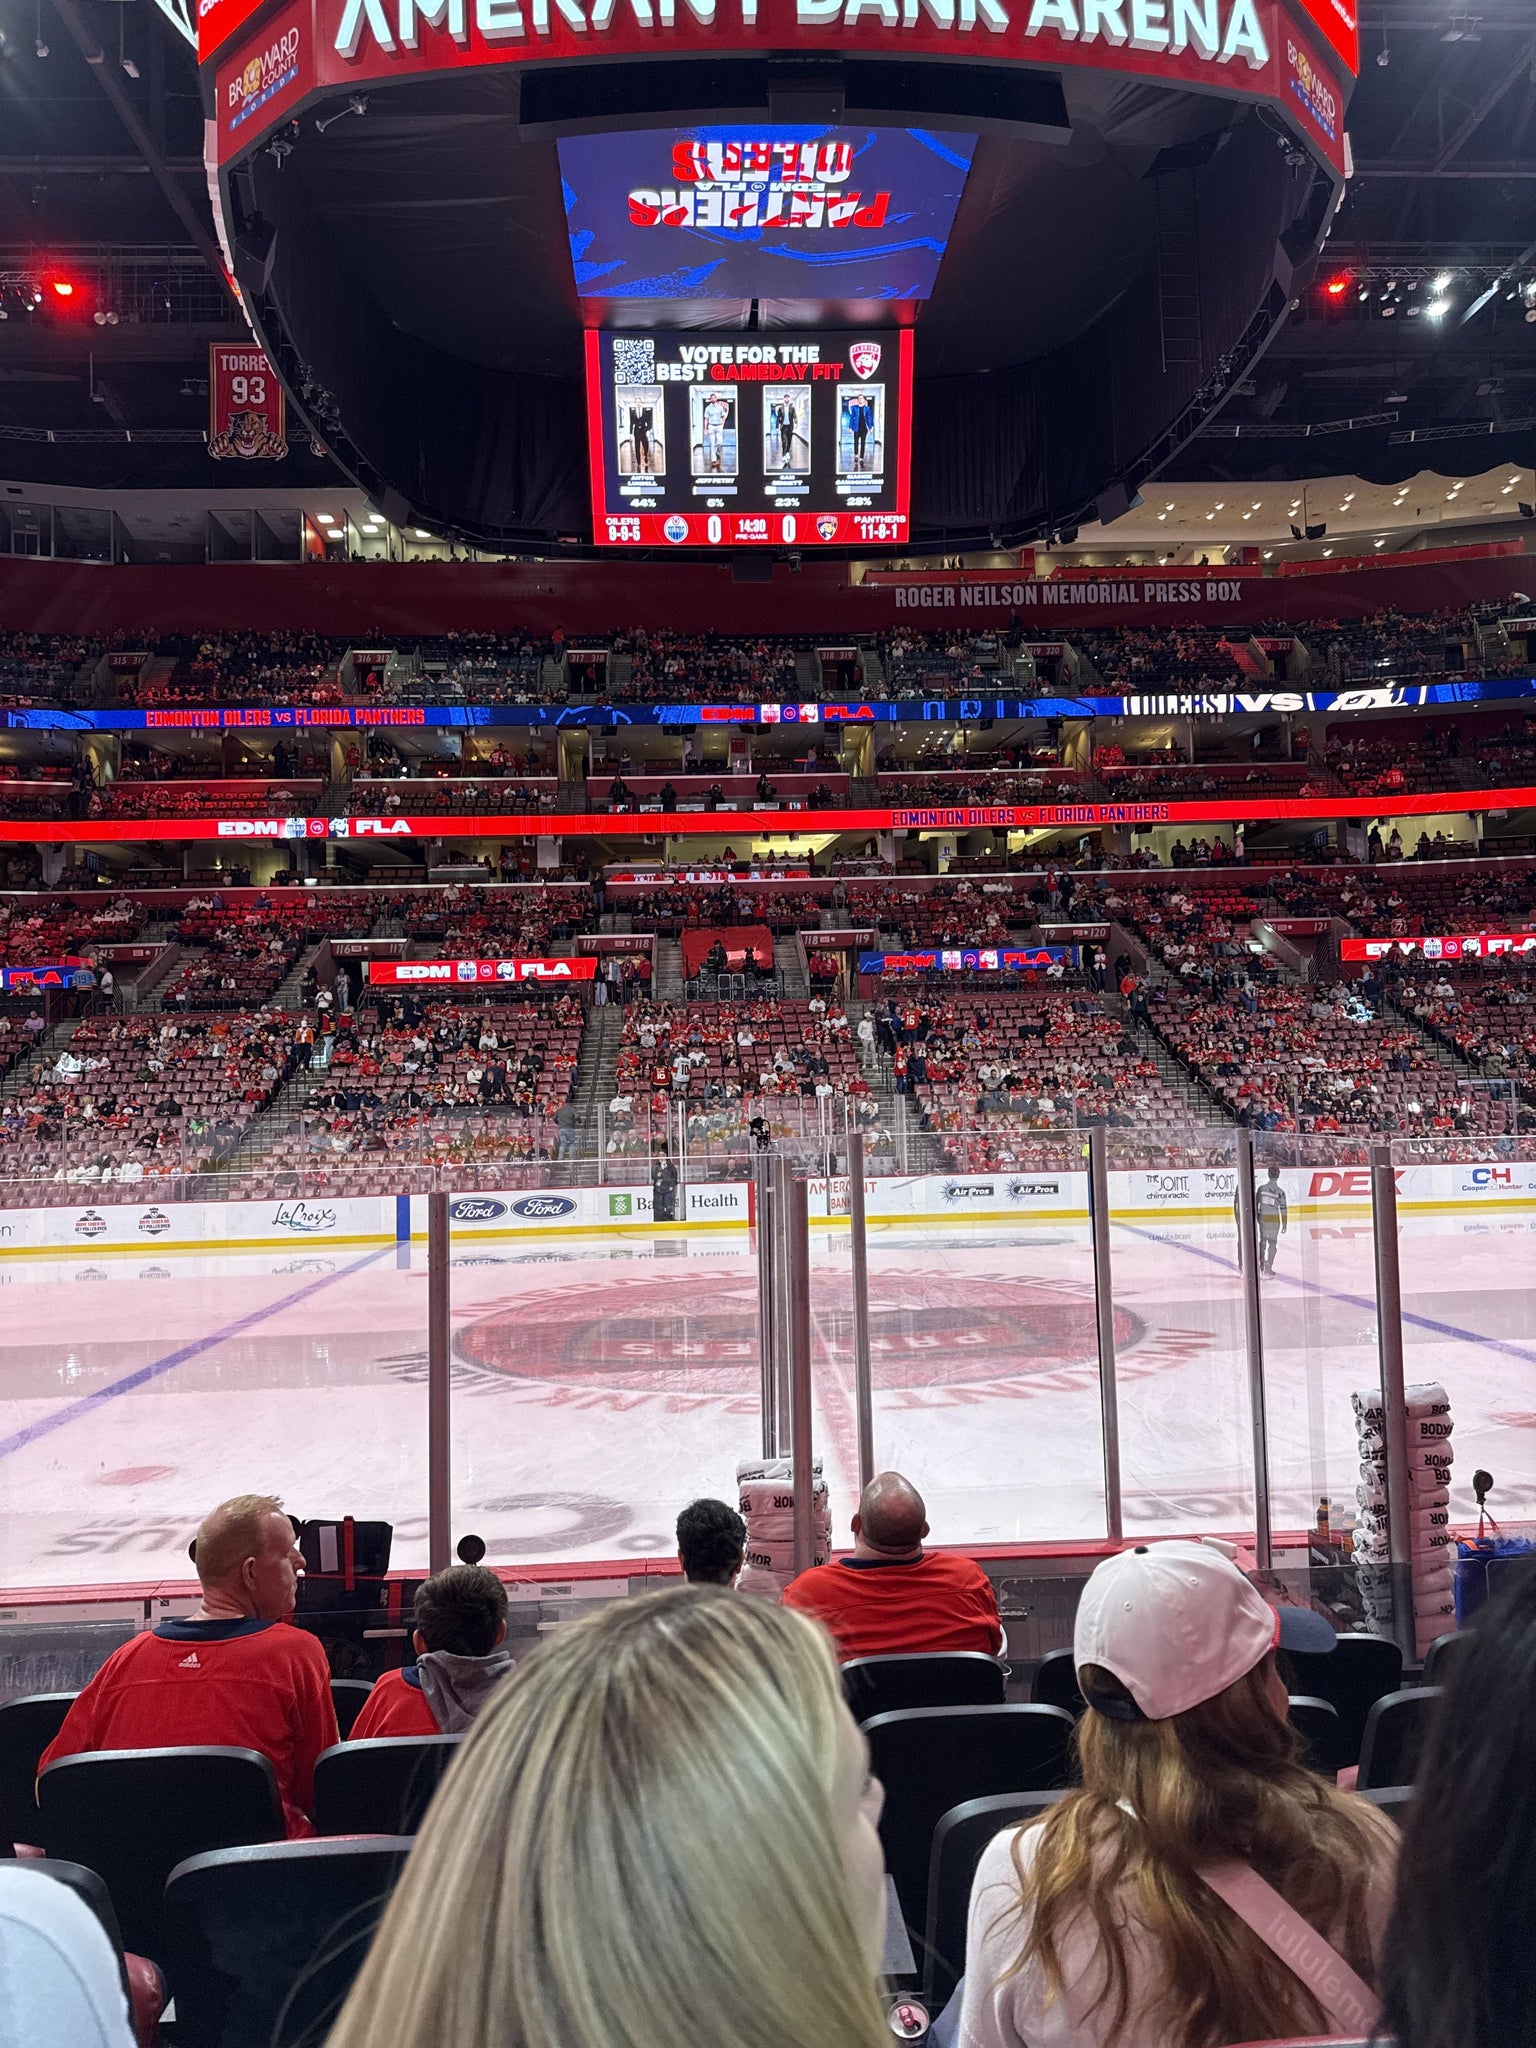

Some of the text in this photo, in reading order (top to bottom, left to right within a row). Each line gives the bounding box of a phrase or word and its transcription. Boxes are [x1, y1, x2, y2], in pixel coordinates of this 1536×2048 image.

[261, 49, 298, 90] COUNTY
[231, 68, 297, 129] FLORIDA
[672, 141, 854, 183] OILERS
[628, 190, 891, 229] PANTHERS
[679, 346, 820, 364] VOTE FOR THE
[220, 354, 273, 372] TORRE
[656, 363, 844, 381] BEST GAMEDAY FIT
[231, 376, 266, 404] 93
[630, 498, 657, 508] 44%
[605, 517, 641, 526] OILERS
[738, 519, 766, 533] 14:30
[854, 515, 907, 523] PANTHERS
[608, 526, 641, 541] 9-9-5
[707, 515, 722, 543] 0
[782, 515, 797, 543] 0
[860, 523, 898, 539] 11-8-1
[895, 581, 1242, 607] ROGER NEILSON MEMORIAL PRESS BOX
[840, 651, 853, 660] 319
[1045, 646, 1060, 655] 320
[112, 656, 127, 665] 315
[357, 654, 371, 663] 316
[571, 654, 585, 663] 317
[1235, 692, 1304, 712] VS
[146, 710, 220, 727] EDMONTON
[223, 710, 271, 726] OILERS
[295, 709, 352, 725] FLORIDA
[355, 708, 425, 724] PANTHERS
[701, 707, 755, 720] EDM
[824, 705, 875, 719] FLA
[892, 810, 964, 827] EDMONTON
[968, 808, 1015, 825] OILERS
[1039, 806, 1095, 823] FLORIDA
[1100, 804, 1169, 821] PANTHERS
[217, 821, 278, 835] EDM
[355, 819, 411, 834] FLA
[1090, 928, 1107, 937] 120
[1314, 921, 1327, 932] 121
[583, 939, 650, 950] 117 118
[805, 934, 869, 945] 118 119
[336, 944, 350, 954] 116
[884, 955, 936, 968] EDM
[1003, 952, 1053, 964] FLA
[396, 965, 451, 979] EDM
[521, 962, 572, 976] FLA
[904, 1016, 915, 1026] 16
[680, 1064, 690, 1075] 10
[1146, 1174, 1159, 1183] THE
[953, 1187, 990, 1196] Air Pros
[1018, 1185, 1055, 1194] Air Pros
[1462, 1184, 1487, 1192] Cooper
[691, 1193, 739, 1208] Health
[1146, 1192, 1190, 1200] chiropractic
[455, 1201, 495, 1219] Ford
[524, 1198, 564, 1216] Ford
[619, 1331, 990, 1355] PANTERS
[1266, 1912, 1372, 2028] lululem
